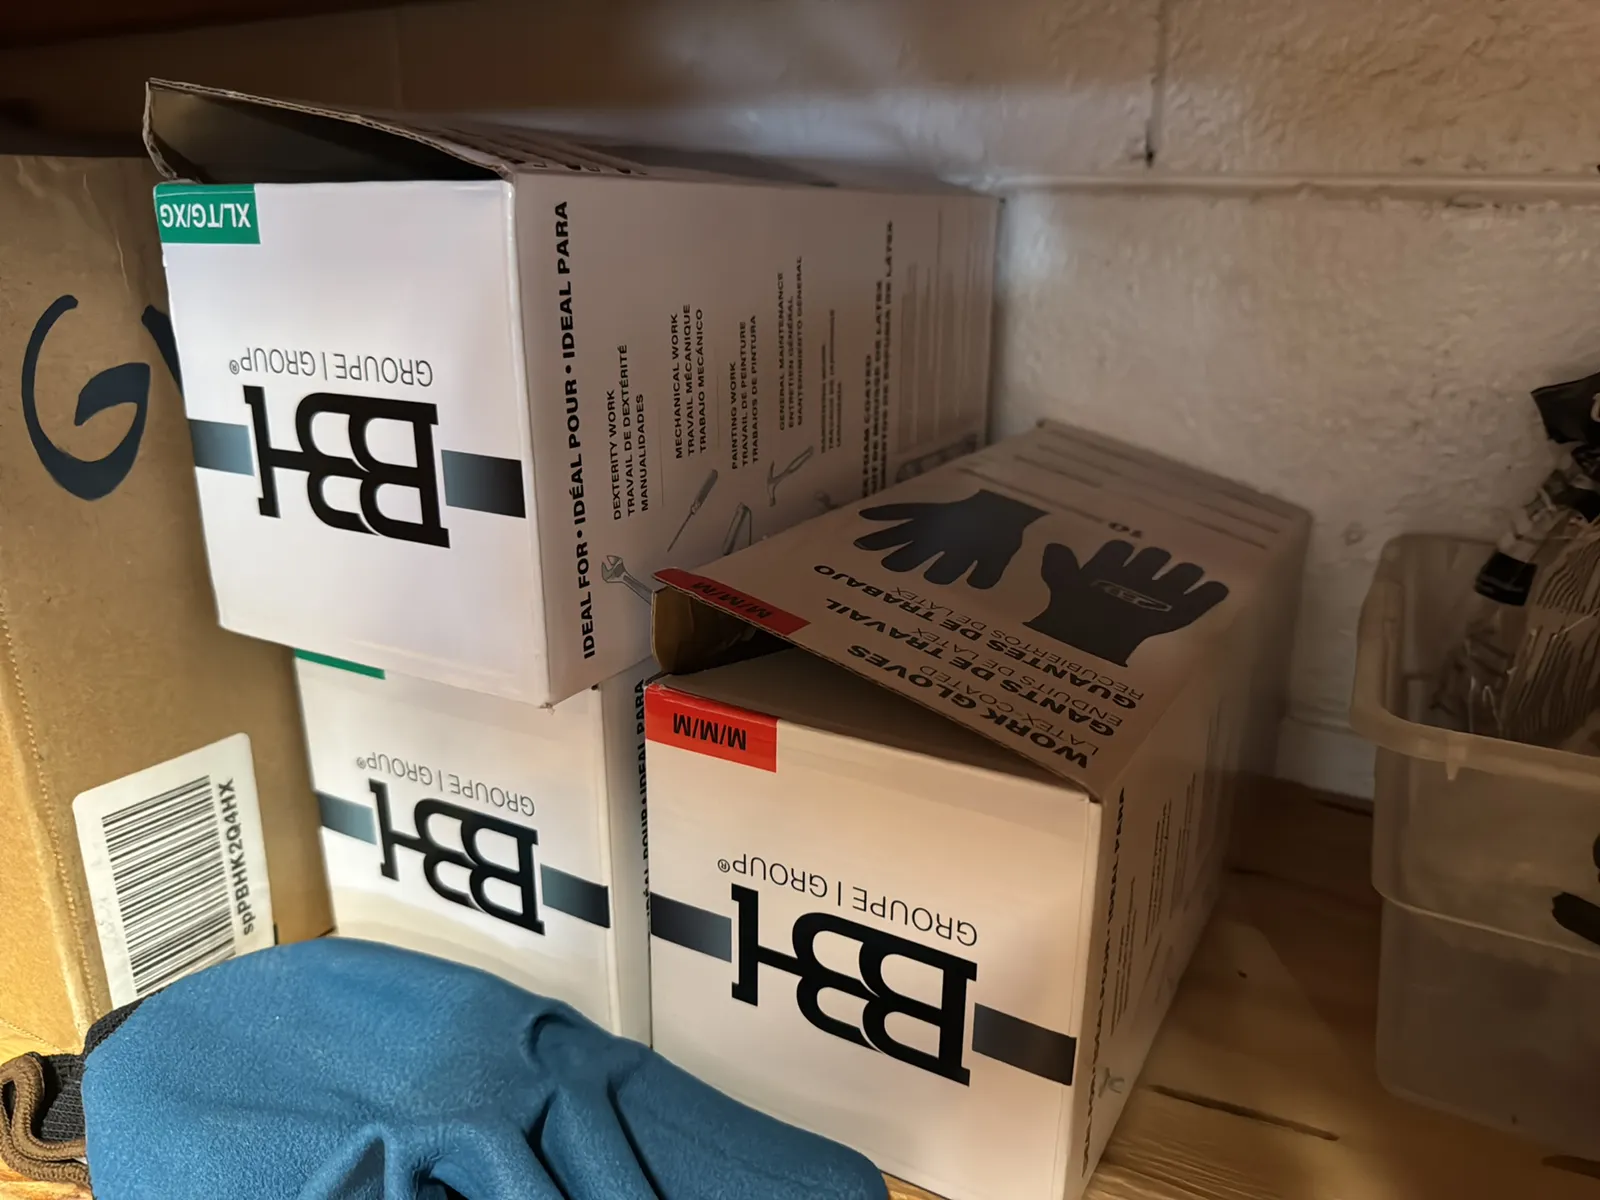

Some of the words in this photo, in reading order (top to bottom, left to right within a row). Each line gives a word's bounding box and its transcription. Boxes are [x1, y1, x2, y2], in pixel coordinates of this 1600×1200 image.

[160, 203, 251, 228] XL/TG/XG
[554, 201, 571, 275] PARA
[559, 281, 576, 358] IDEAL
[670, 313, 679, 360] WORK
[683, 304, 693, 394] MÉCANIQUE
[694, 309, 705, 387] MECÁNICO
[750, 315, 758, 374] PINTURA
[333, 353, 433, 387] GROUPE
[617, 344, 631, 427] DEXTÉRITÉ
[729, 361, 738, 405] WORK
[751, 379, 758, 395] DE
[565, 379, 581, 449] POUR
[606, 389, 618, 438] WORK
[671, 362, 684, 459] MECHANICAL
[686, 399, 696, 457] TRAVAIL
[698, 391, 707, 453] TRABAJO
[741, 393, 748, 408] DE
[622, 431, 633, 452] DE
[635, 394, 649, 512] MANUALIDADES
[729, 407, 739, 469] PAINTING
[741, 408, 749, 467] TRAVAIL
[751, 398, 759, 464] TRABAJOS
[569, 453, 586, 525] IDÉAL
[609, 441, 622, 520] DEXTERITY
[623, 455, 636, 517] TRAVAIL
[576, 542, 591, 588] FOR
[813, 565, 937, 622] TRABAJO
[580, 592, 596, 659] IDEAL
[826, 598, 944, 660] TRAVAIL
[890, 586, 955, 617] LATEX
[939, 619, 983, 641] DE
[955, 615, 987, 631] DE
[911, 628, 980, 660] LATEX
[949, 656, 996, 681] DE
[981, 659, 1016, 677] DE
[990, 629, 1145, 701] RECUBIERTOS
[847, 645, 977, 709] GLOVES
[985, 639, 1137, 709] GUANTES
[1019, 675, 1124, 727] ENDUITS
[634, 680, 645, 734] PARA
[673, 713, 747, 750] M/M/M
[999, 679, 1115, 737] GANTS
[979, 707, 1088, 769] WORK
[448, 773, 535, 816] GROUPE
[852, 886, 978, 946] GROUPE
